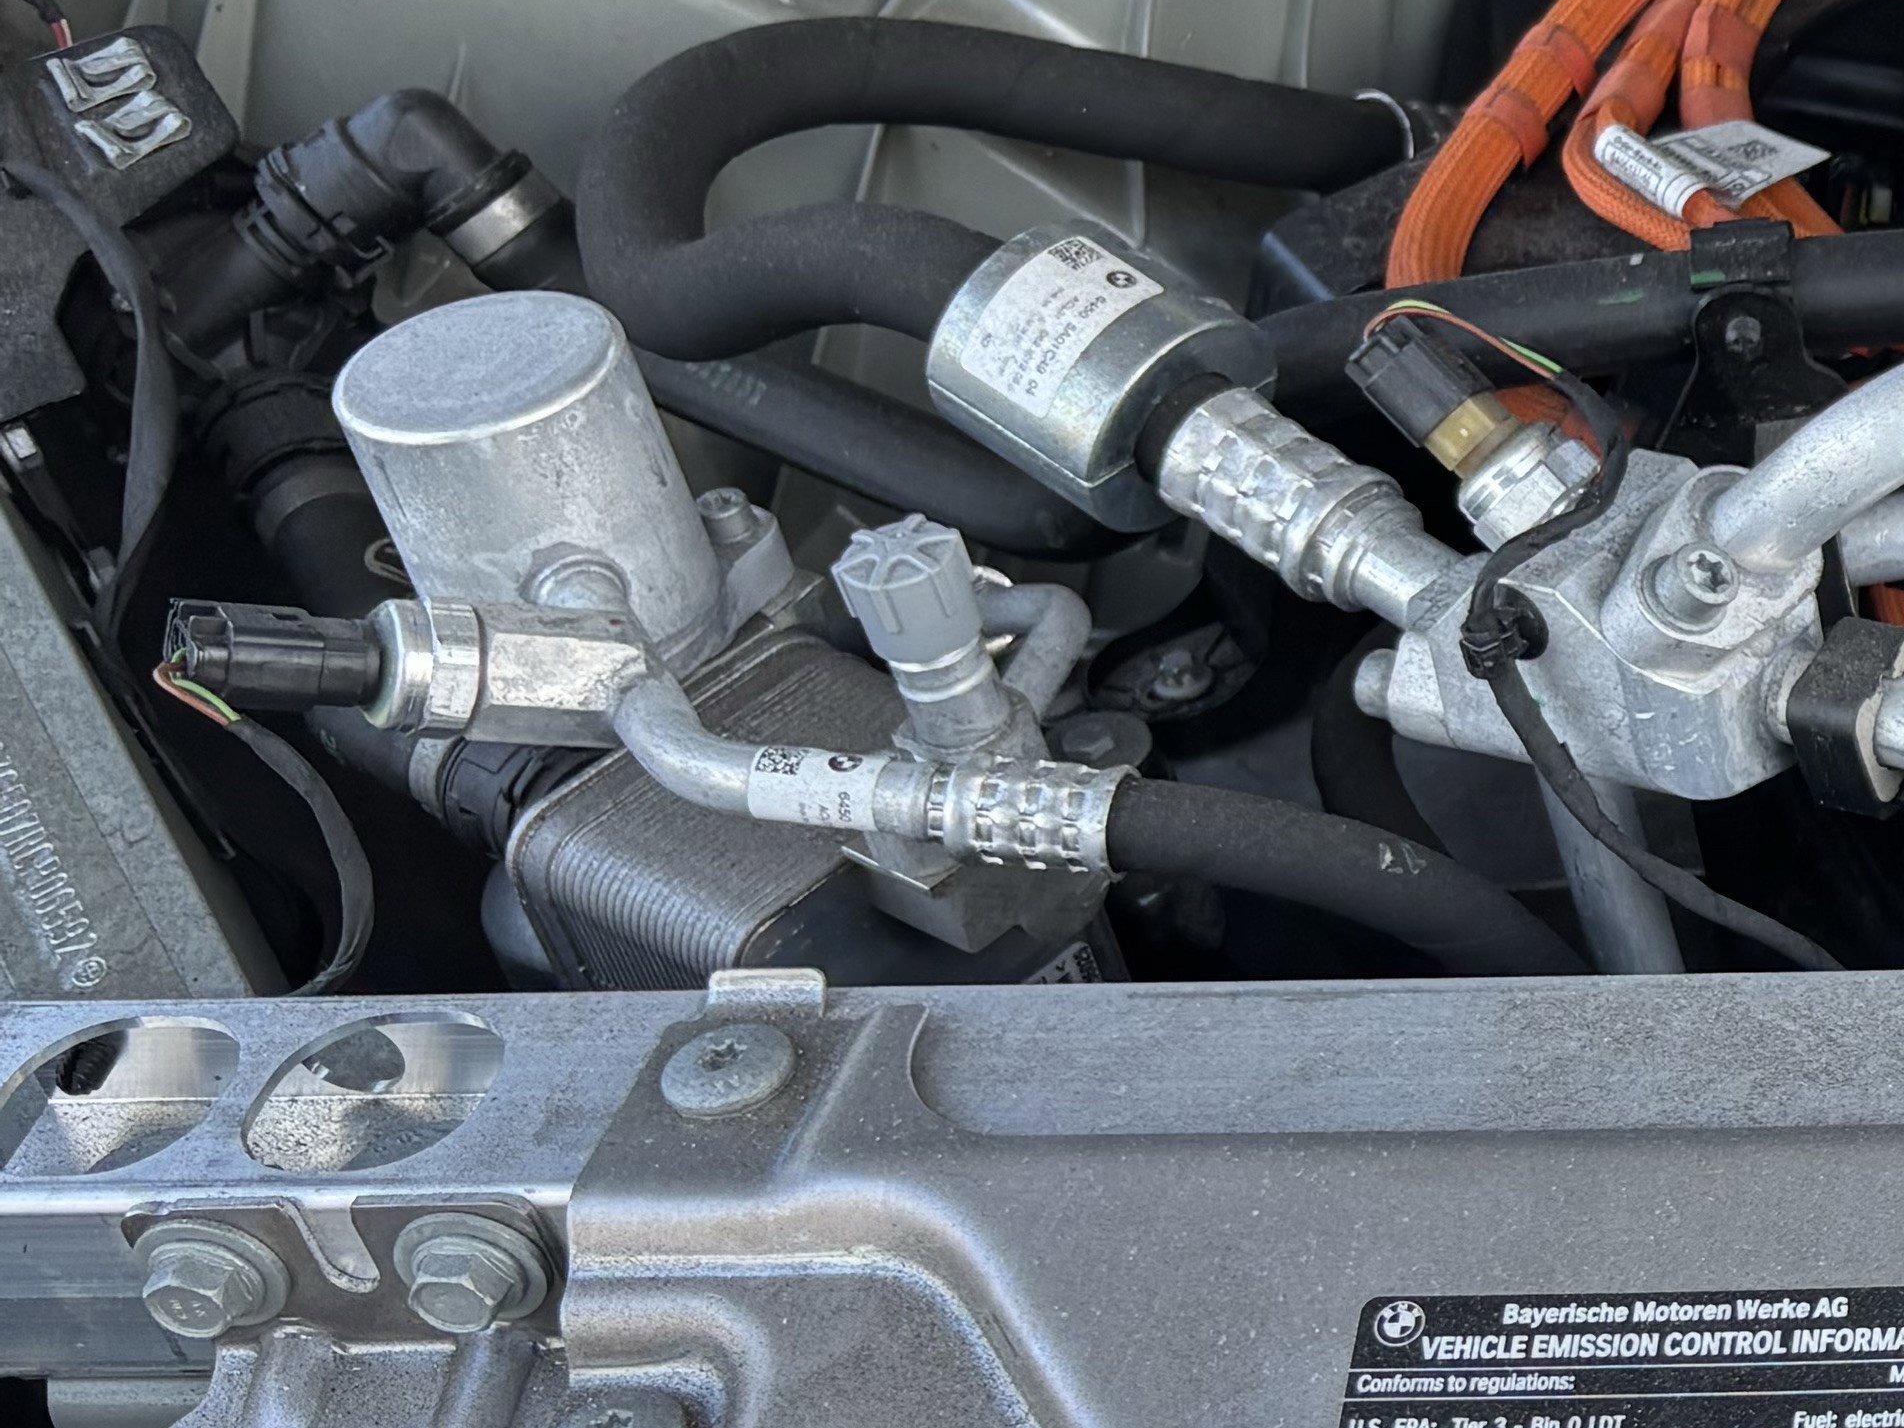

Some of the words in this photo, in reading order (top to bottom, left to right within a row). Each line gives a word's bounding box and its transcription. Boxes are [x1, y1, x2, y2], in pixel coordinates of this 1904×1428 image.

[1503, 1303, 1629, 1328] Bayerische
[1633, 1301, 1732, 1322] Motoren
[1737, 1298, 1811, 1320] Werke
[1811, 1296, 1849, 1319] AG
[1422, 1335, 1527, 1361] VEHICLE
[1531, 1332, 1659, 1359] EMISSION
[1664, 1329, 1788, 1357] CONTROL
[1357, 1374, 1445, 1393] Conforms
[1447, 1375, 1467, 1392] to
[1469, 1372, 1577, 1395] regulations:
